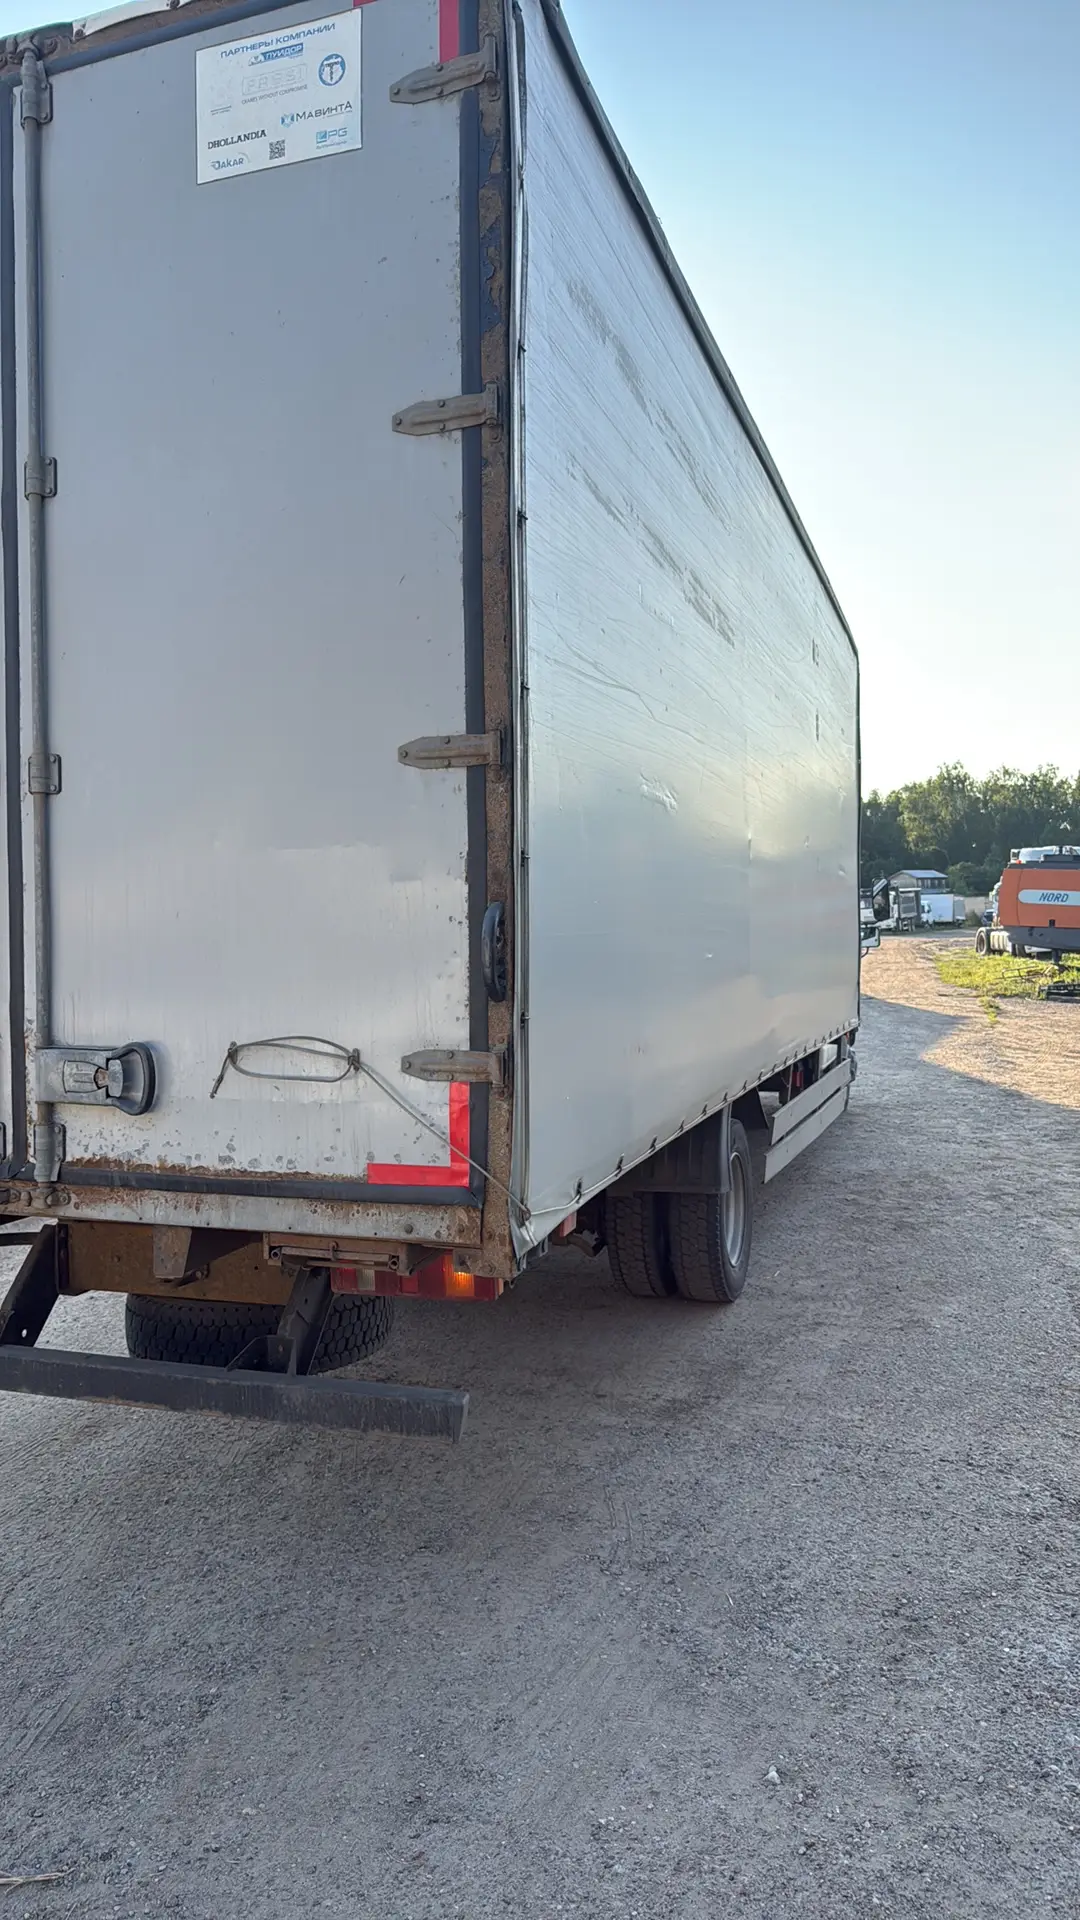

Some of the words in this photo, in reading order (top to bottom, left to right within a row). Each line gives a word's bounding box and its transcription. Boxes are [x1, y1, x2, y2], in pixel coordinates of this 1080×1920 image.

[220, 39, 274, 59] ПАРТНЕРЫ
[275, 22, 336, 47] КОМПАНИИ
[207, 129, 267, 150] DHOLLANDIA
[1039, 892, 1069, 903] NORD
